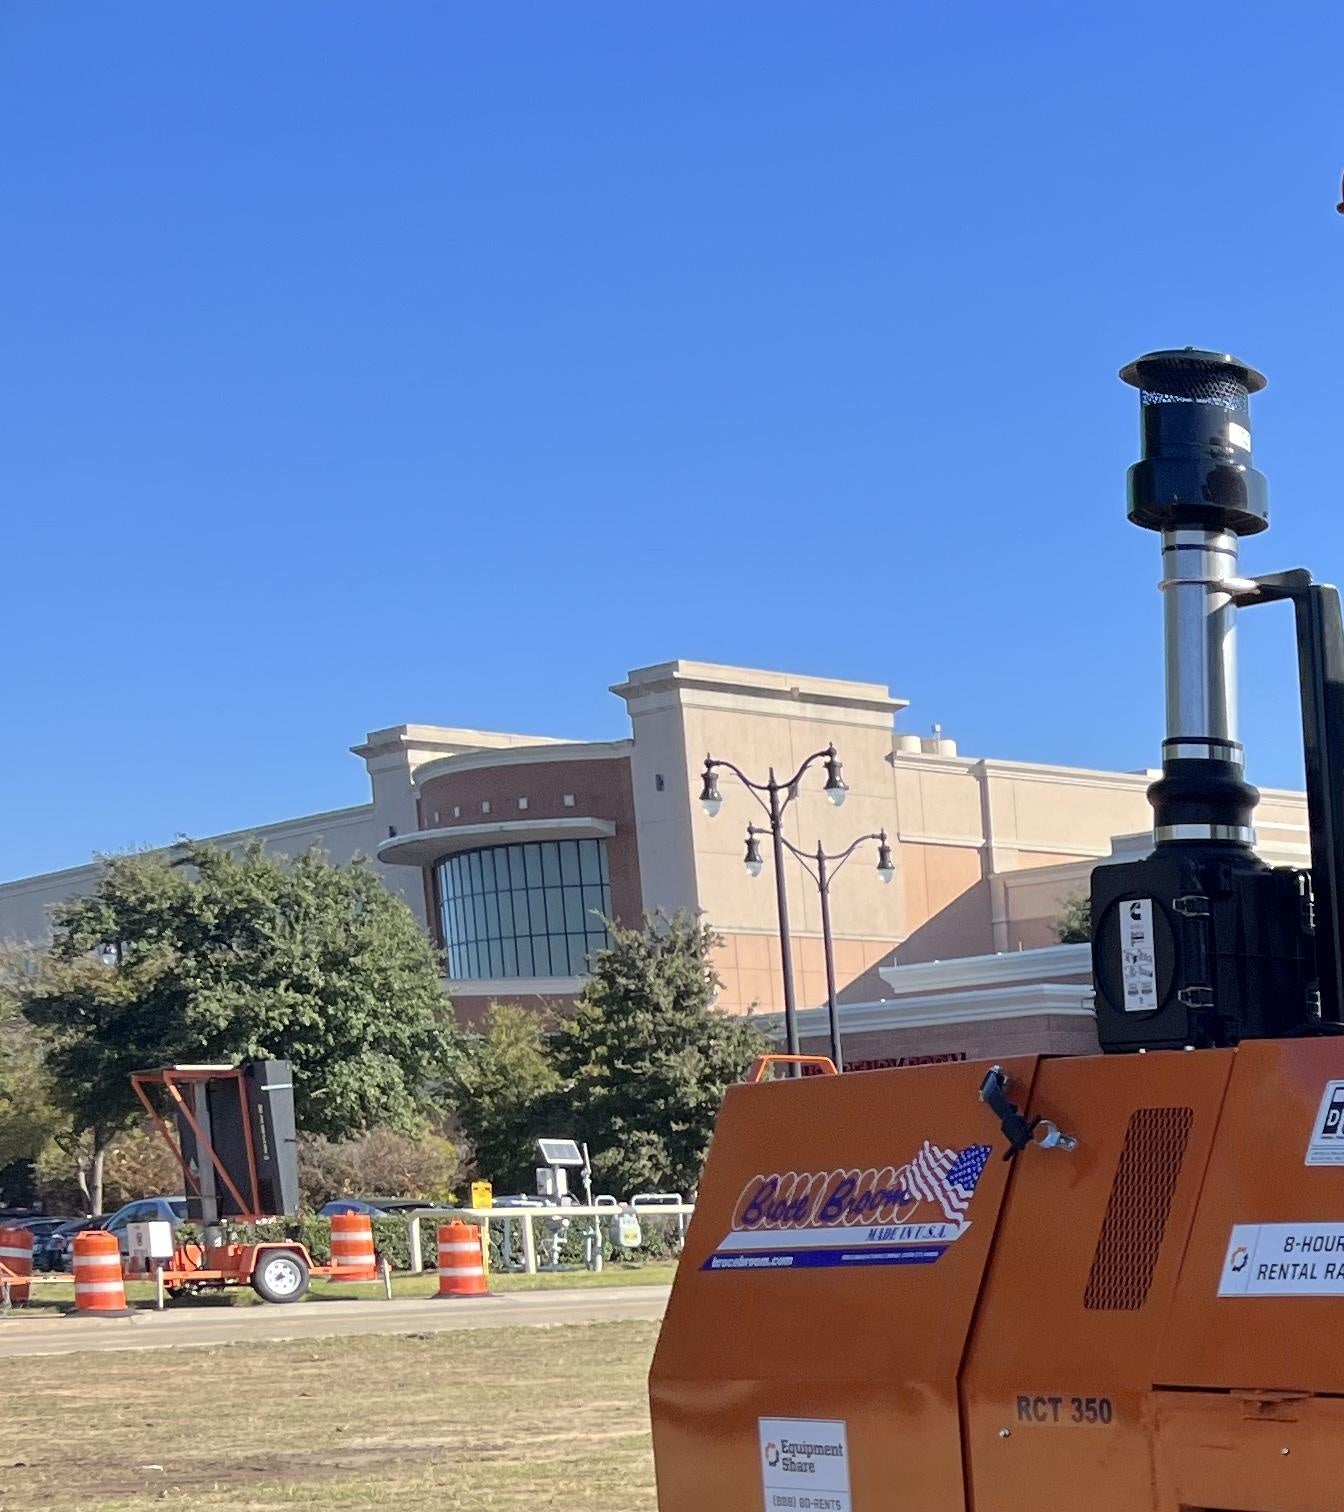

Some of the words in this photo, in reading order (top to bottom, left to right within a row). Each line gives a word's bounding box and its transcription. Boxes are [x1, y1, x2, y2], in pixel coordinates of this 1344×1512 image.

[864, 1227, 899, 1241] MADE
[1256, 1263, 1318, 1281] RENTAL
[1016, 1395, 1063, 1422] RCT
[1070, 1397, 1113, 1425] 350
[780, 1439, 844, 1458] Equipment
[781, 1457, 816, 1473] Share
